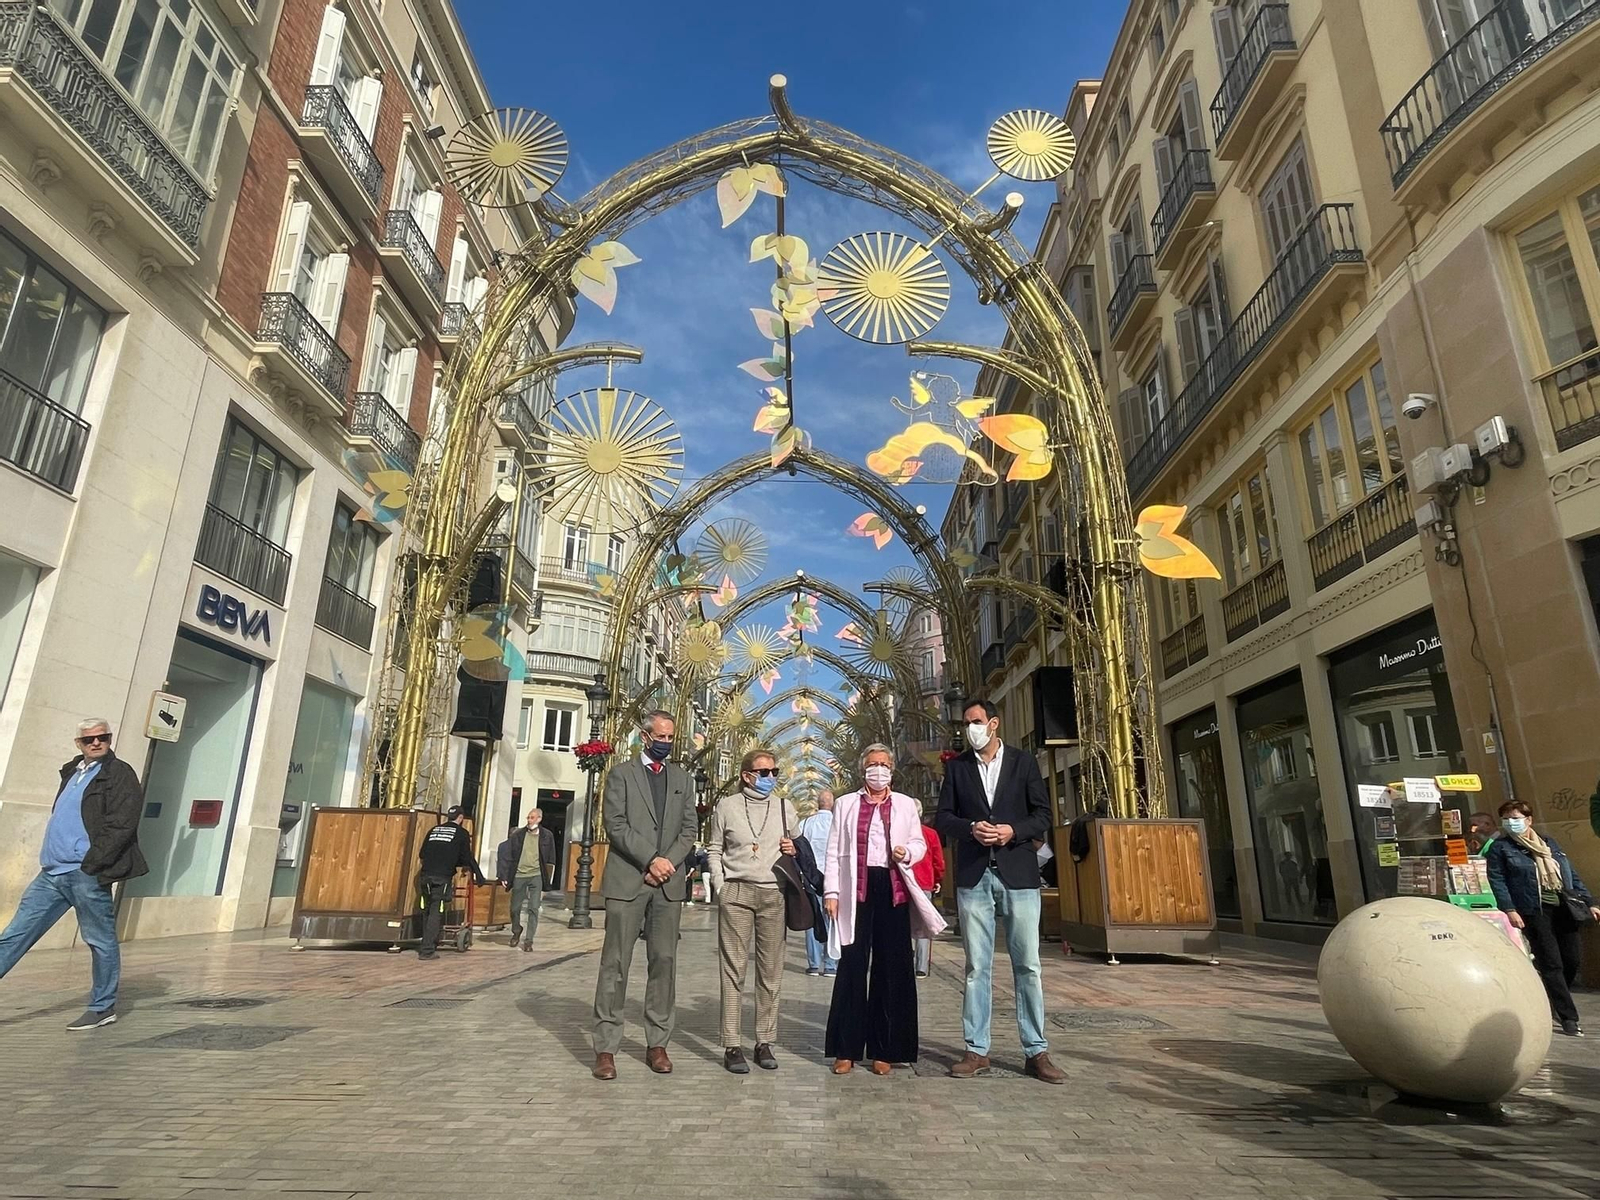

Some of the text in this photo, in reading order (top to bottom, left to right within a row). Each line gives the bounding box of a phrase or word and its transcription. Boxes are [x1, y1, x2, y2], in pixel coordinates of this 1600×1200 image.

[196, 584, 271, 643] BBVA
[1379, 636, 1442, 670] Massimo Dutti
[1450, 778, 1477, 786] ONCE
